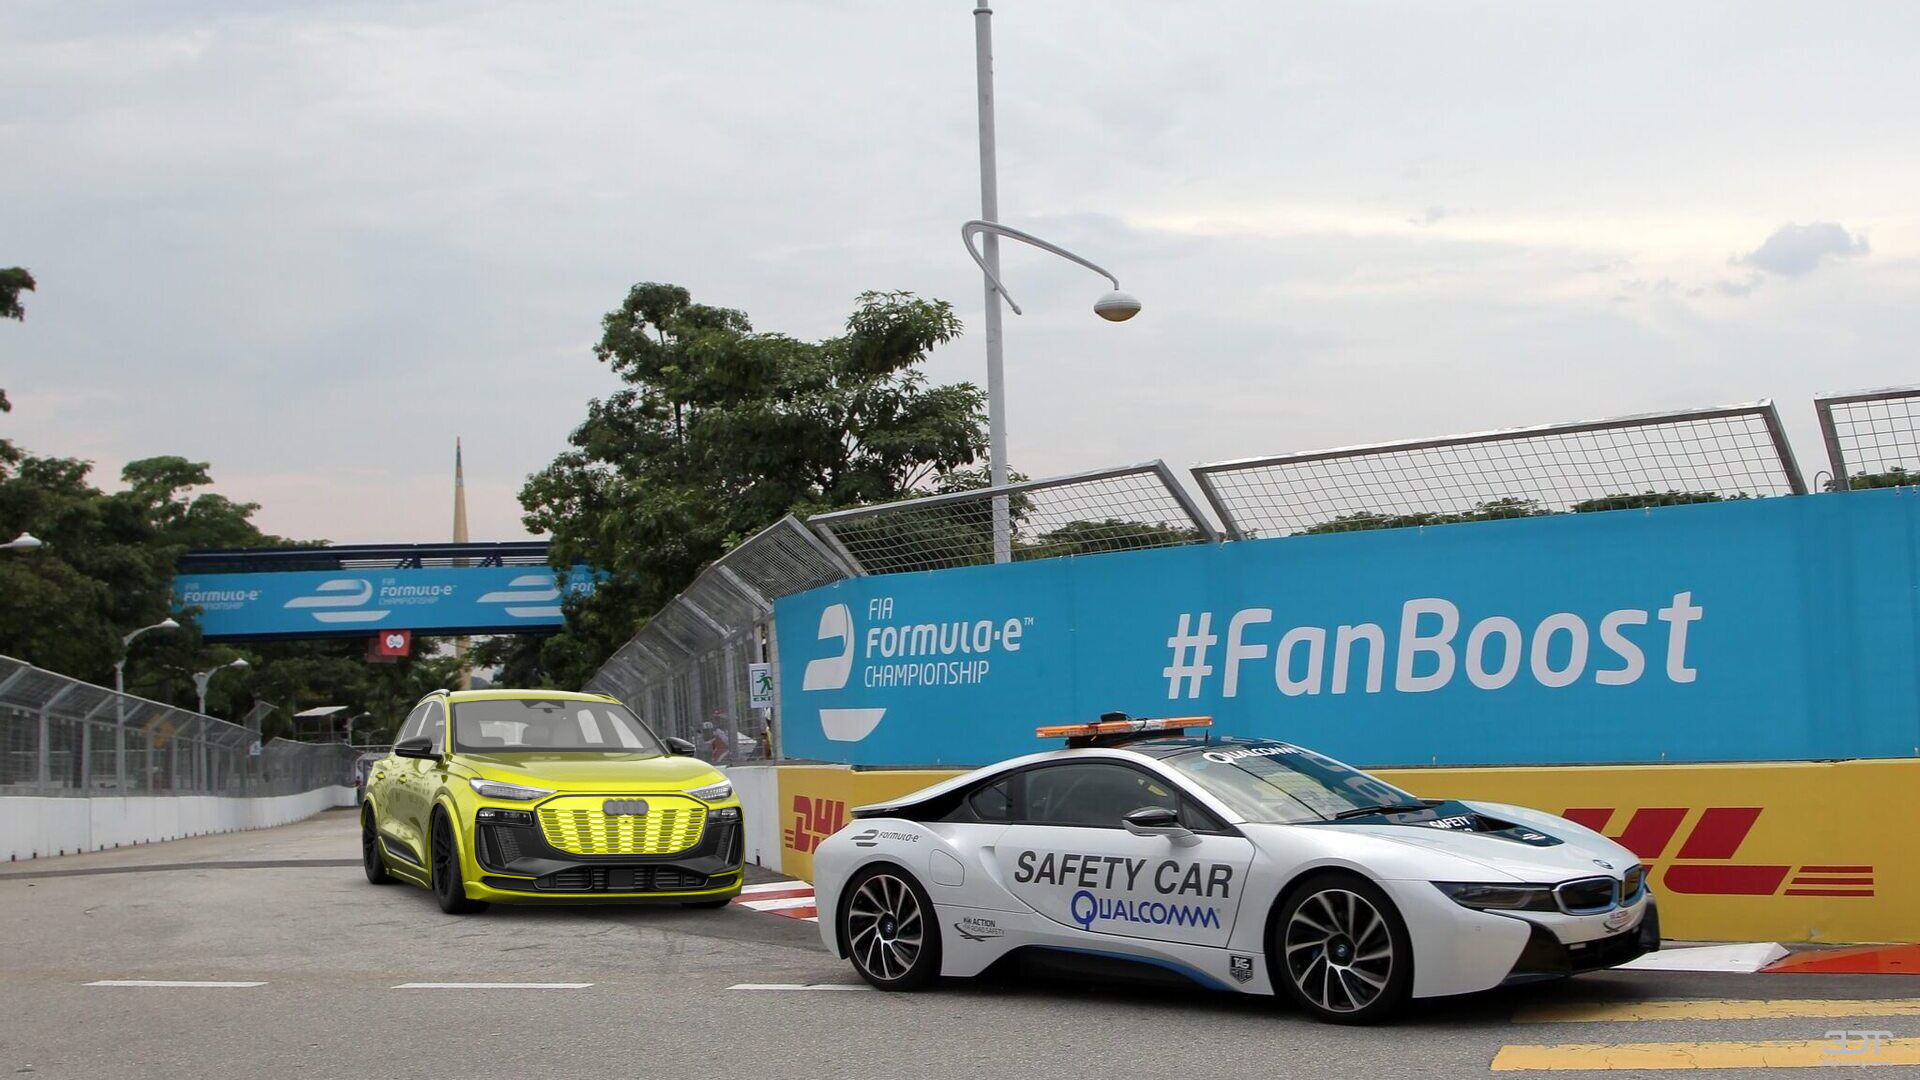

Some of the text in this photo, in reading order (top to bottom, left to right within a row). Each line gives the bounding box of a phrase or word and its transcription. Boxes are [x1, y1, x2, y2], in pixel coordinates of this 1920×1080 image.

[868, 597, 894, 621] FIA
[1162, 590, 1703, 700] #FanBoost
[864, 660, 990, 688] CHAMPIONSHIP
[1428, 815, 1471, 830] SAFETY
[1014, 850, 1234, 899] SAFETY CAR
[972, 918, 997, 928] ACTION
[1070, 889, 1221, 932] QUALCOMM
